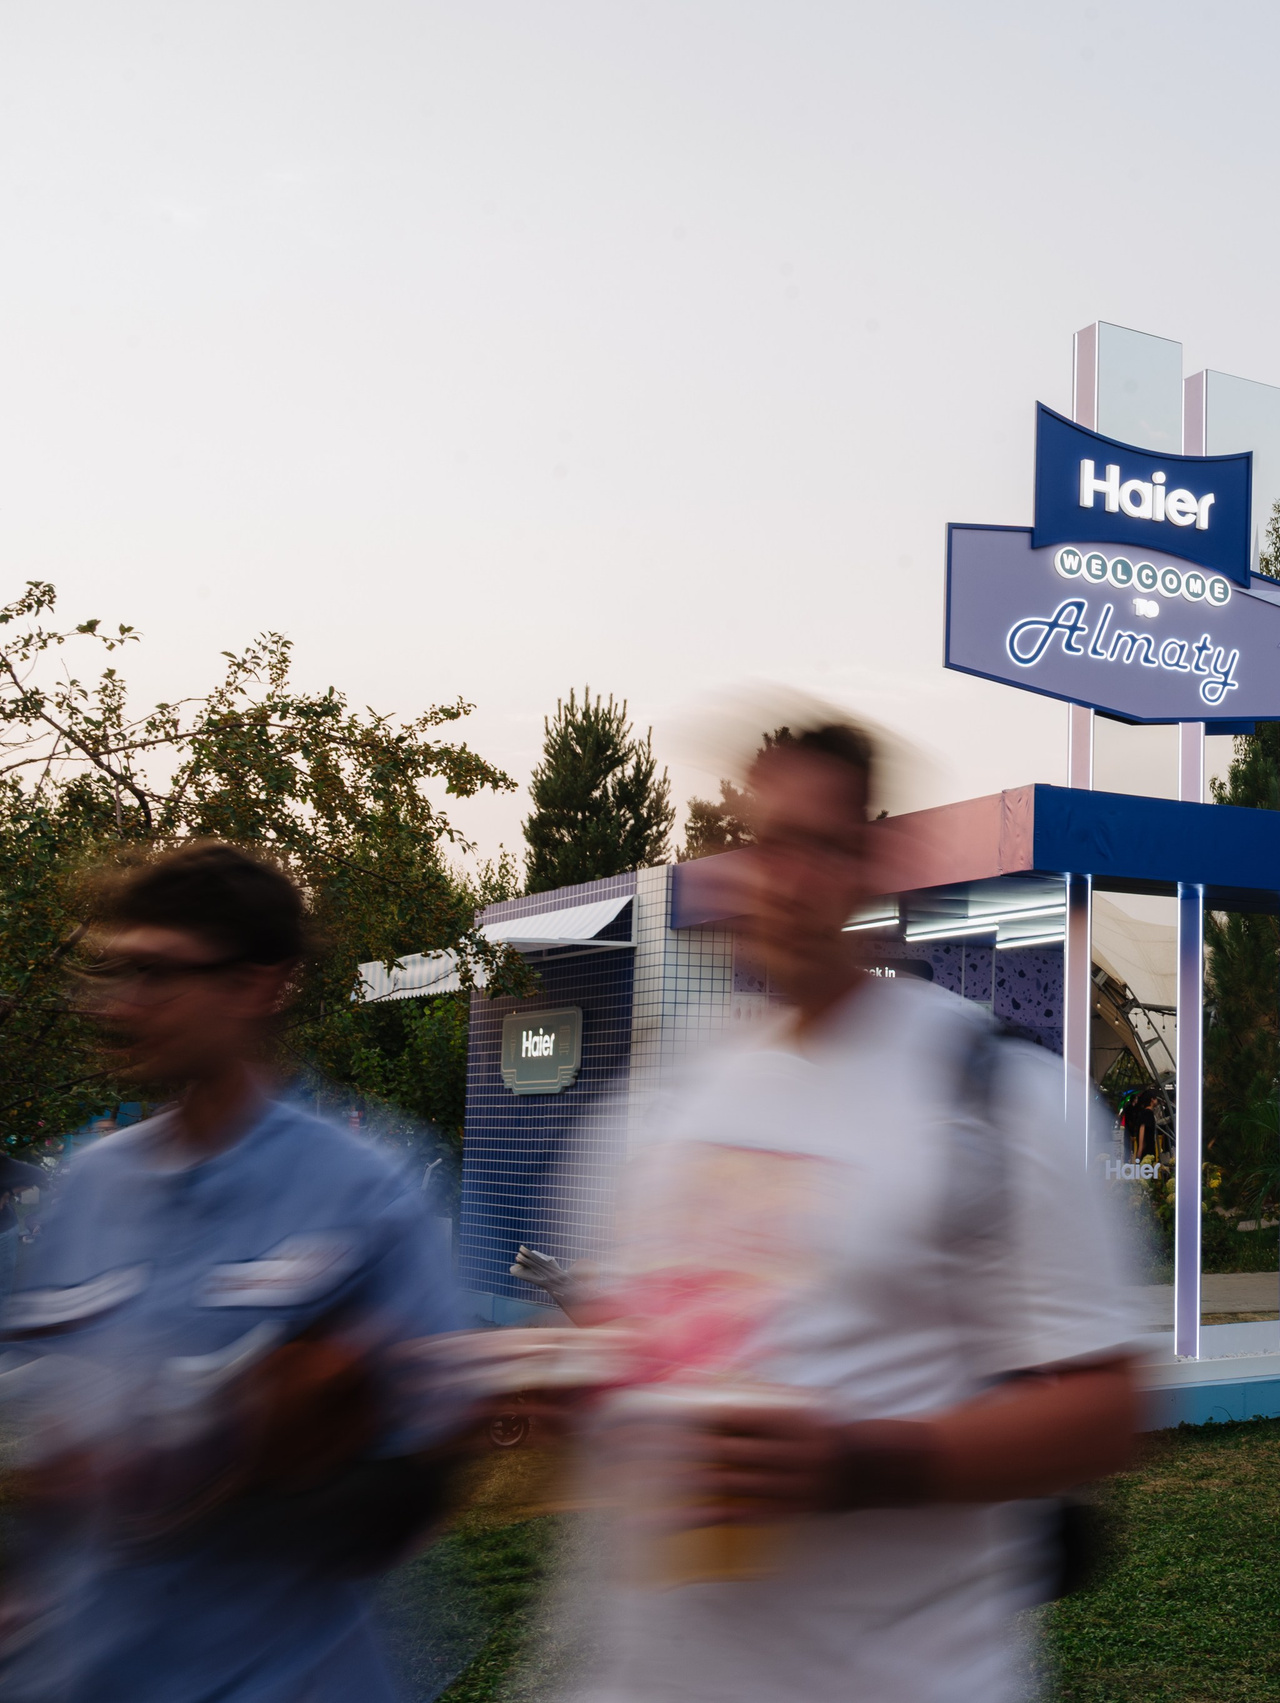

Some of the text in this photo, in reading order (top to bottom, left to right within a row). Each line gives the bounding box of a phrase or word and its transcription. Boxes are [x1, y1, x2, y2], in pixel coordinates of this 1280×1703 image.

[1079, 458, 1216, 531] Haier
[1060, 551, 1227, 601] WELCOME
[1132, 597, 1160, 618] TO
[1006, 597, 1240, 706] Almaty
[521, 1027, 555, 1058] Haier
[1105, 1158, 1161, 1180] Haier
